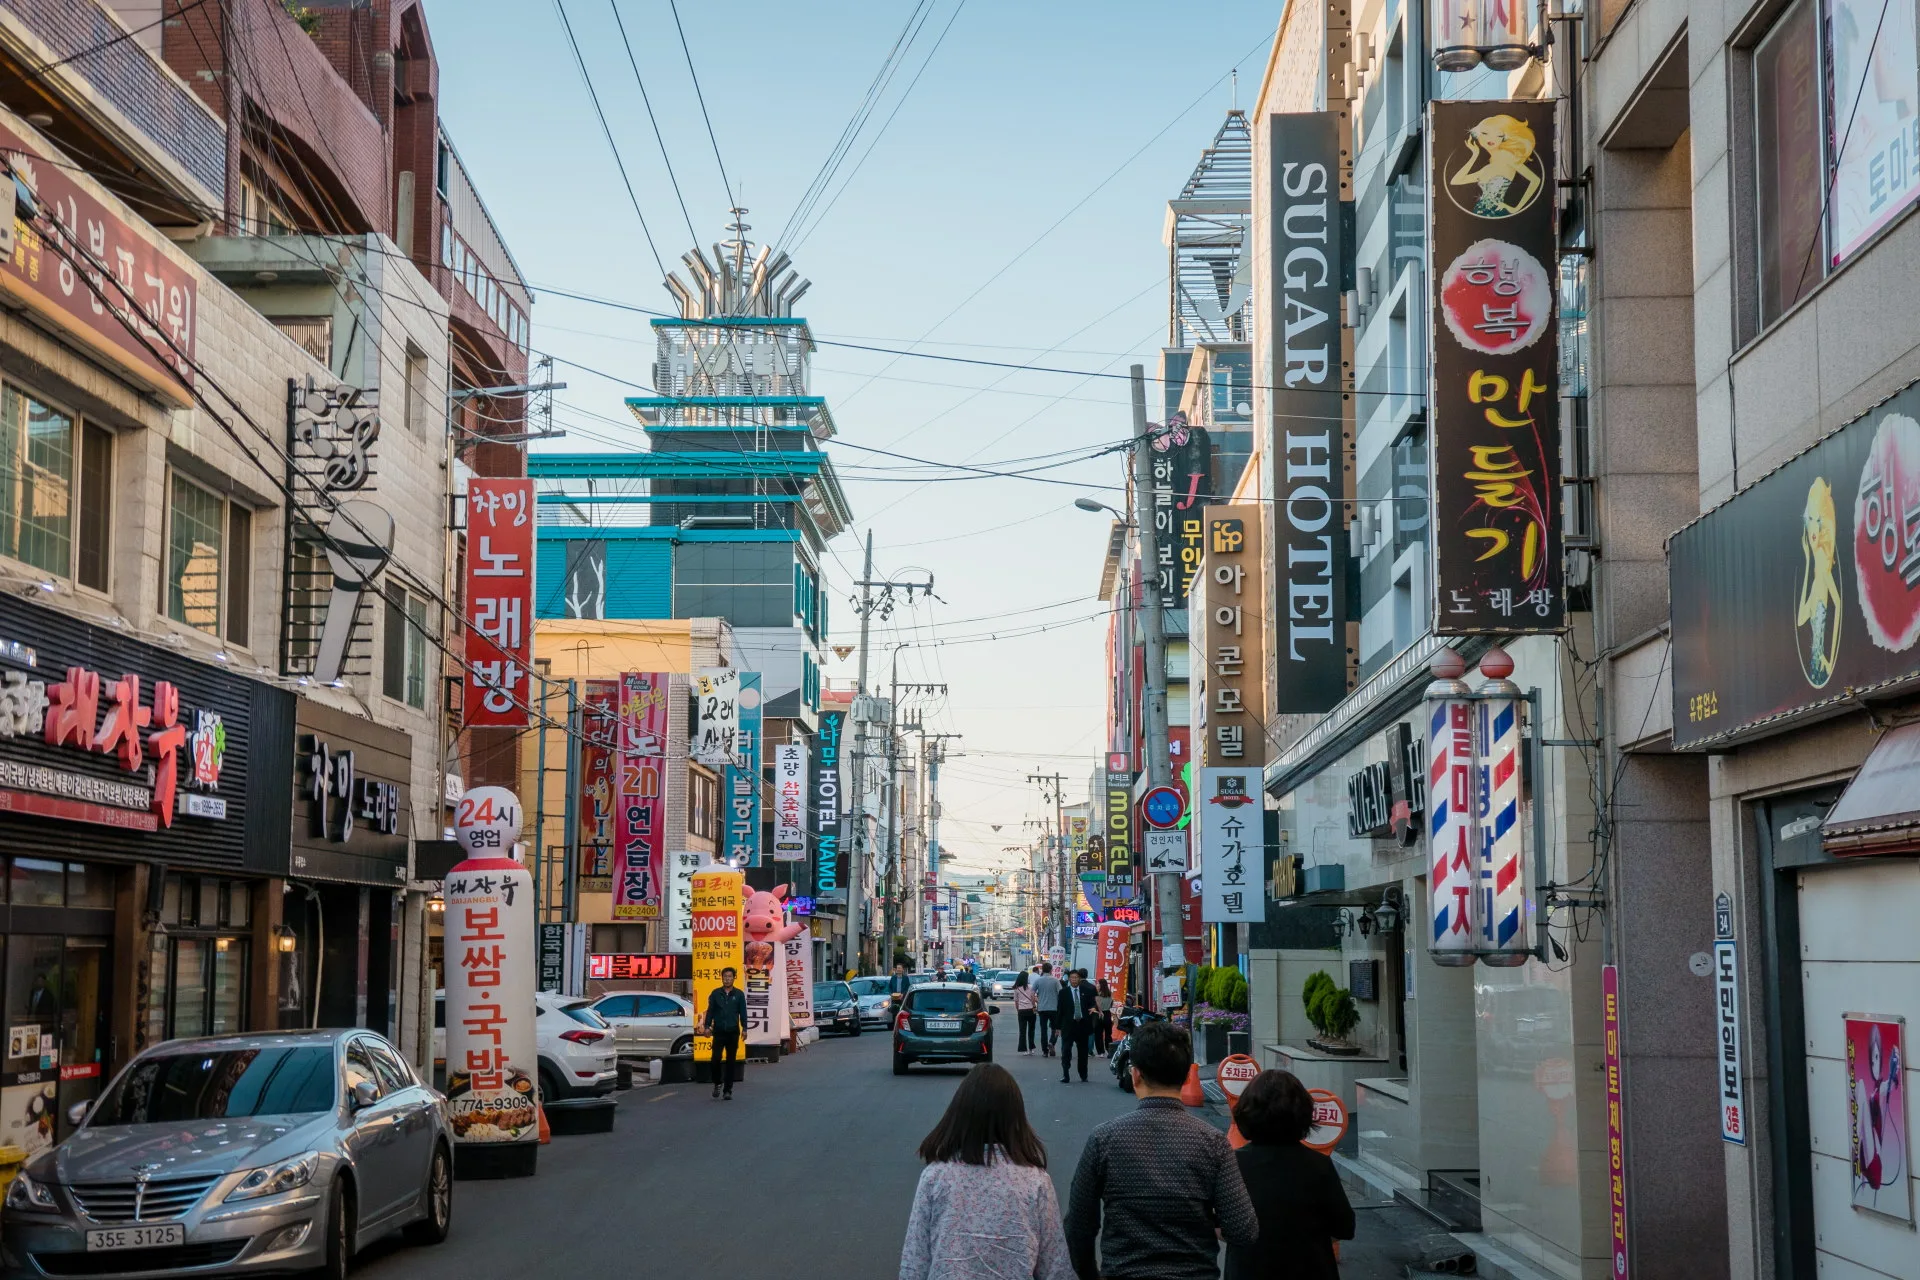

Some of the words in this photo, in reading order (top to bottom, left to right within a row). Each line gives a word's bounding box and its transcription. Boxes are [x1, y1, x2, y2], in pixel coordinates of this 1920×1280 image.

[1281, 161, 1329, 389] SUGAR
[1460, 255, 1531, 343] 행복
[1176, 473, 1206, 511] J
[1464, 366, 1548, 583] 만들기
[1285, 428, 1334, 661] HOTEL
[472, 535, 524, 714] 노래방
[1449, 588, 1552, 617] 노래방
[45, 666, 186, 829] 대장부
[783, 748, 800, 776] 초량
[361, 777, 401, 835] 노래방
[458, 797, 514, 828] 24시
[819, 769, 837, 832] HOTEL
[1348, 761, 1389, 836] SUGAR
[469, 829, 501, 848] 영업
[593, 799, 611, 876] LIVE
[1110, 791, 1129, 874] MOTEL
[1150, 835, 1182, 845] 견인지역
[450, 875, 519, 907] 대장부
[617, 906, 657, 915] 742-2400
[692, 915, 736, 932] 6,000원
[1718, 914, 1730, 933] 34
[1719, 949, 1739, 1100] 도민일보
[1225, 1067, 1255, 1078] 주차금지
[134, 1226, 175, 1245] 3125
